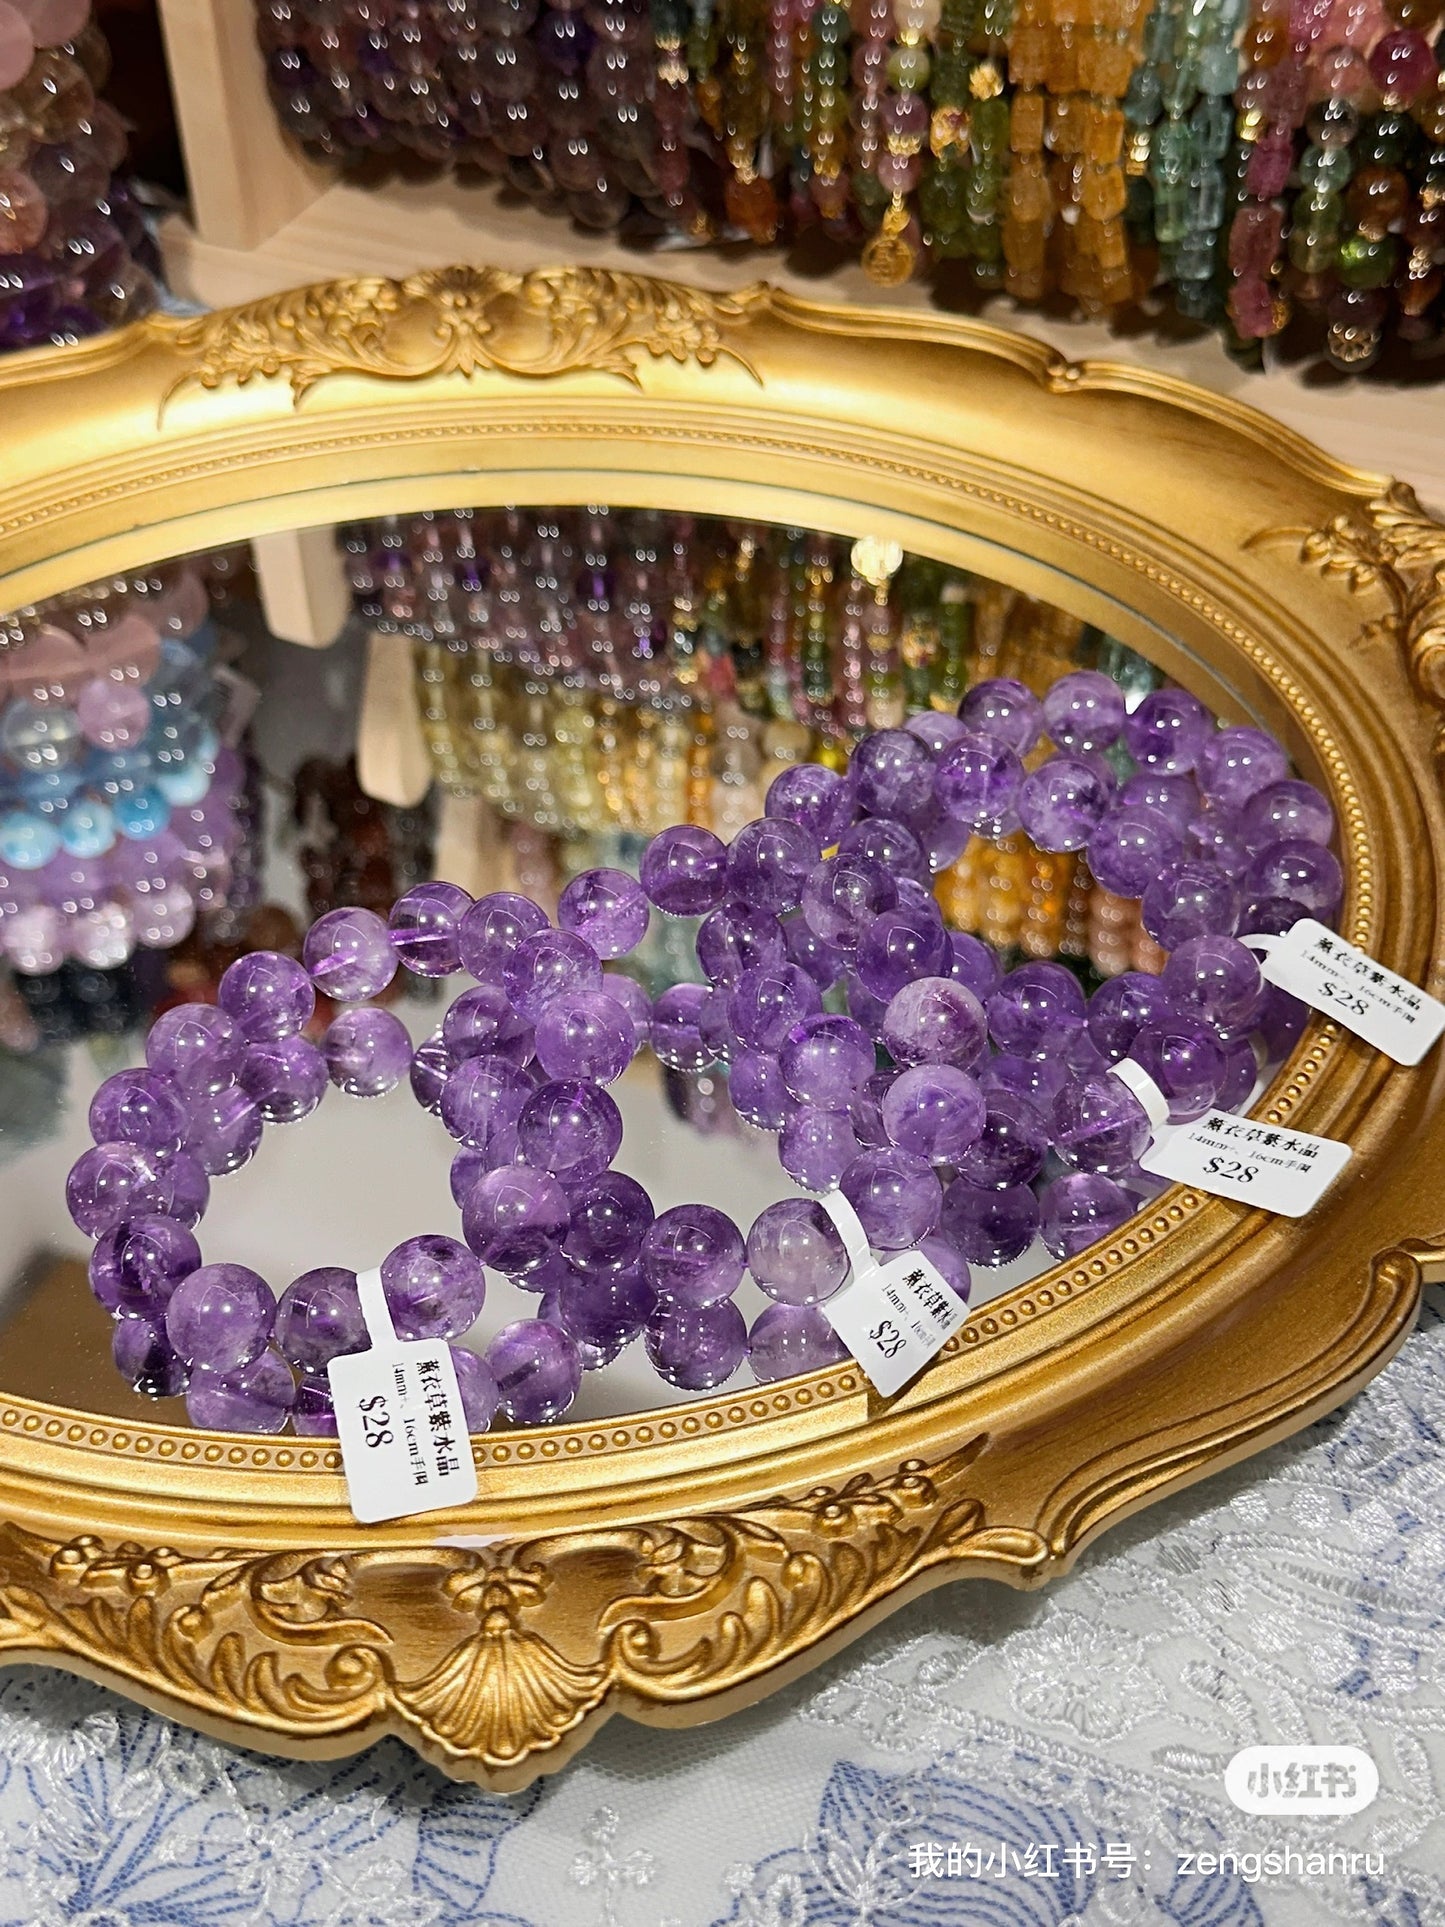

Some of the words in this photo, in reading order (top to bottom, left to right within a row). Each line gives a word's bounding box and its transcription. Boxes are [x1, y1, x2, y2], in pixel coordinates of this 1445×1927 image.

[1317, 981, 1369, 1016] $28
[1202, 1117, 1321, 1159] 薰衣草紫水晶
[1203, 1157, 1259, 1183] $28
[868, 1320, 907, 1358] $28
[357, 1395, 394, 1448] $28
[416, 1359, 460, 1476] 薰衣草紫水晶
